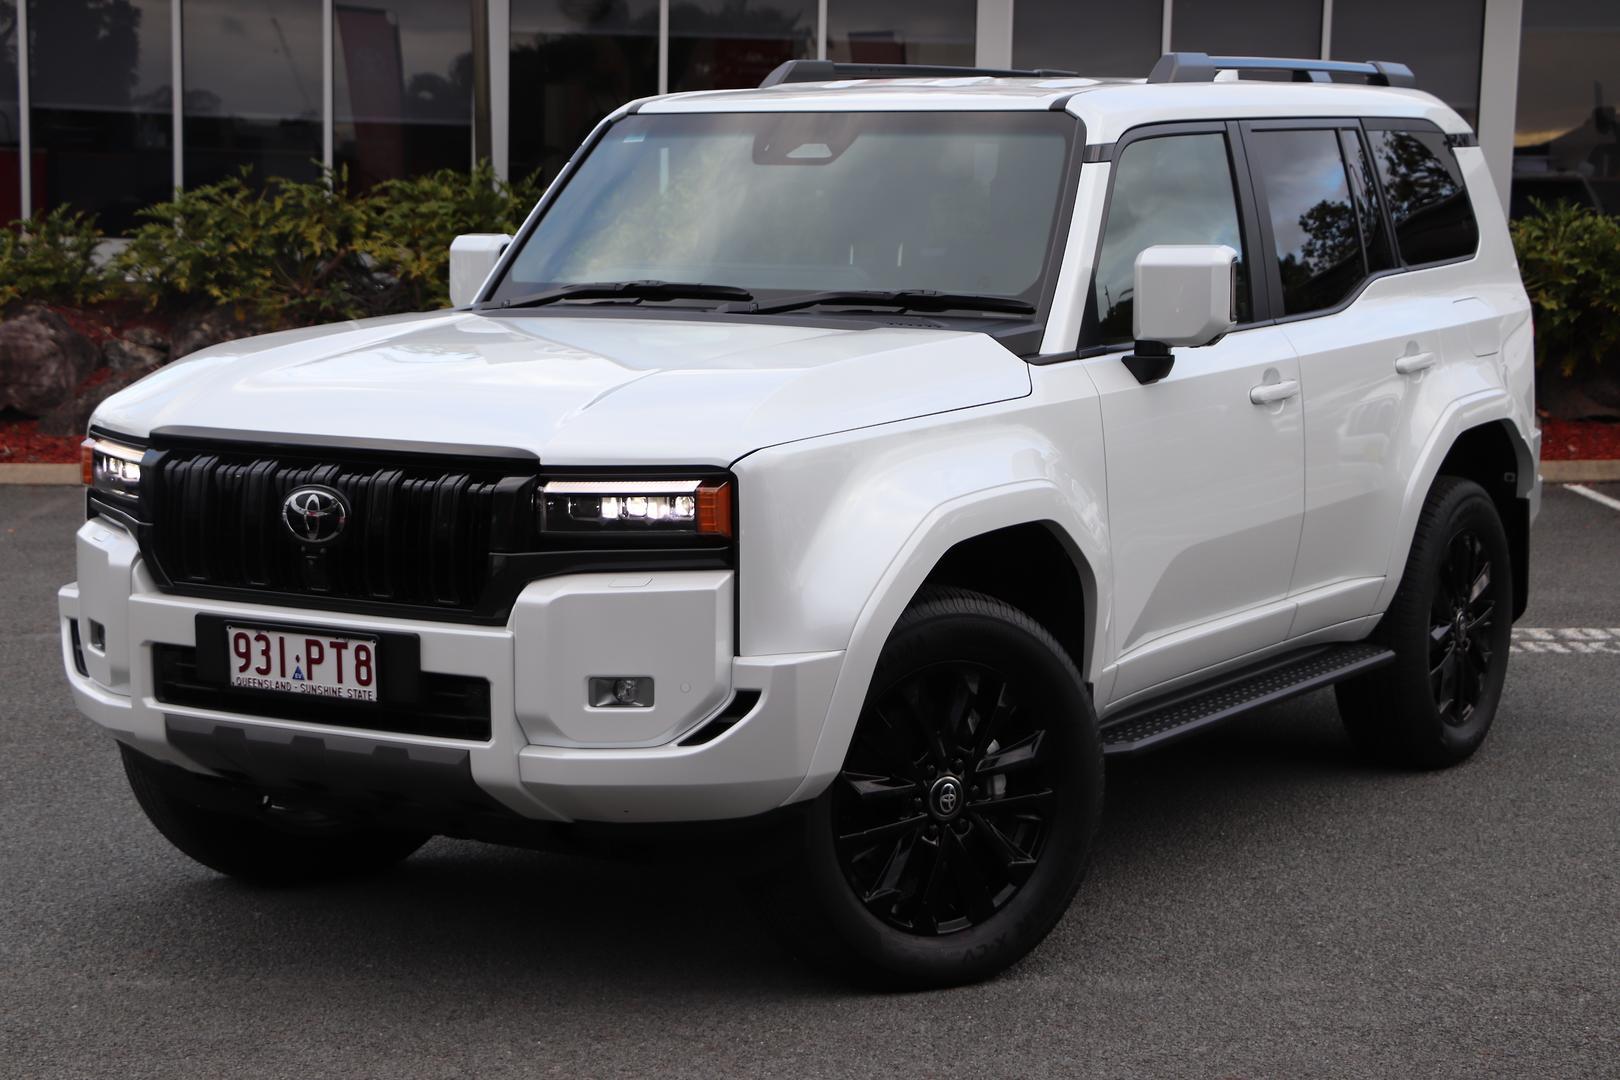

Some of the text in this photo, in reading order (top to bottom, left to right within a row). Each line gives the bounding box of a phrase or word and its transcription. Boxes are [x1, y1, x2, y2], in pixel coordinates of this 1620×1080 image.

[233, 632, 372, 687] 931 PT8
[236, 676, 292, 692] QUEENSLAND
[300, 683, 342, 697] SUNSHINE
[347, 688, 373, 700] STATE
